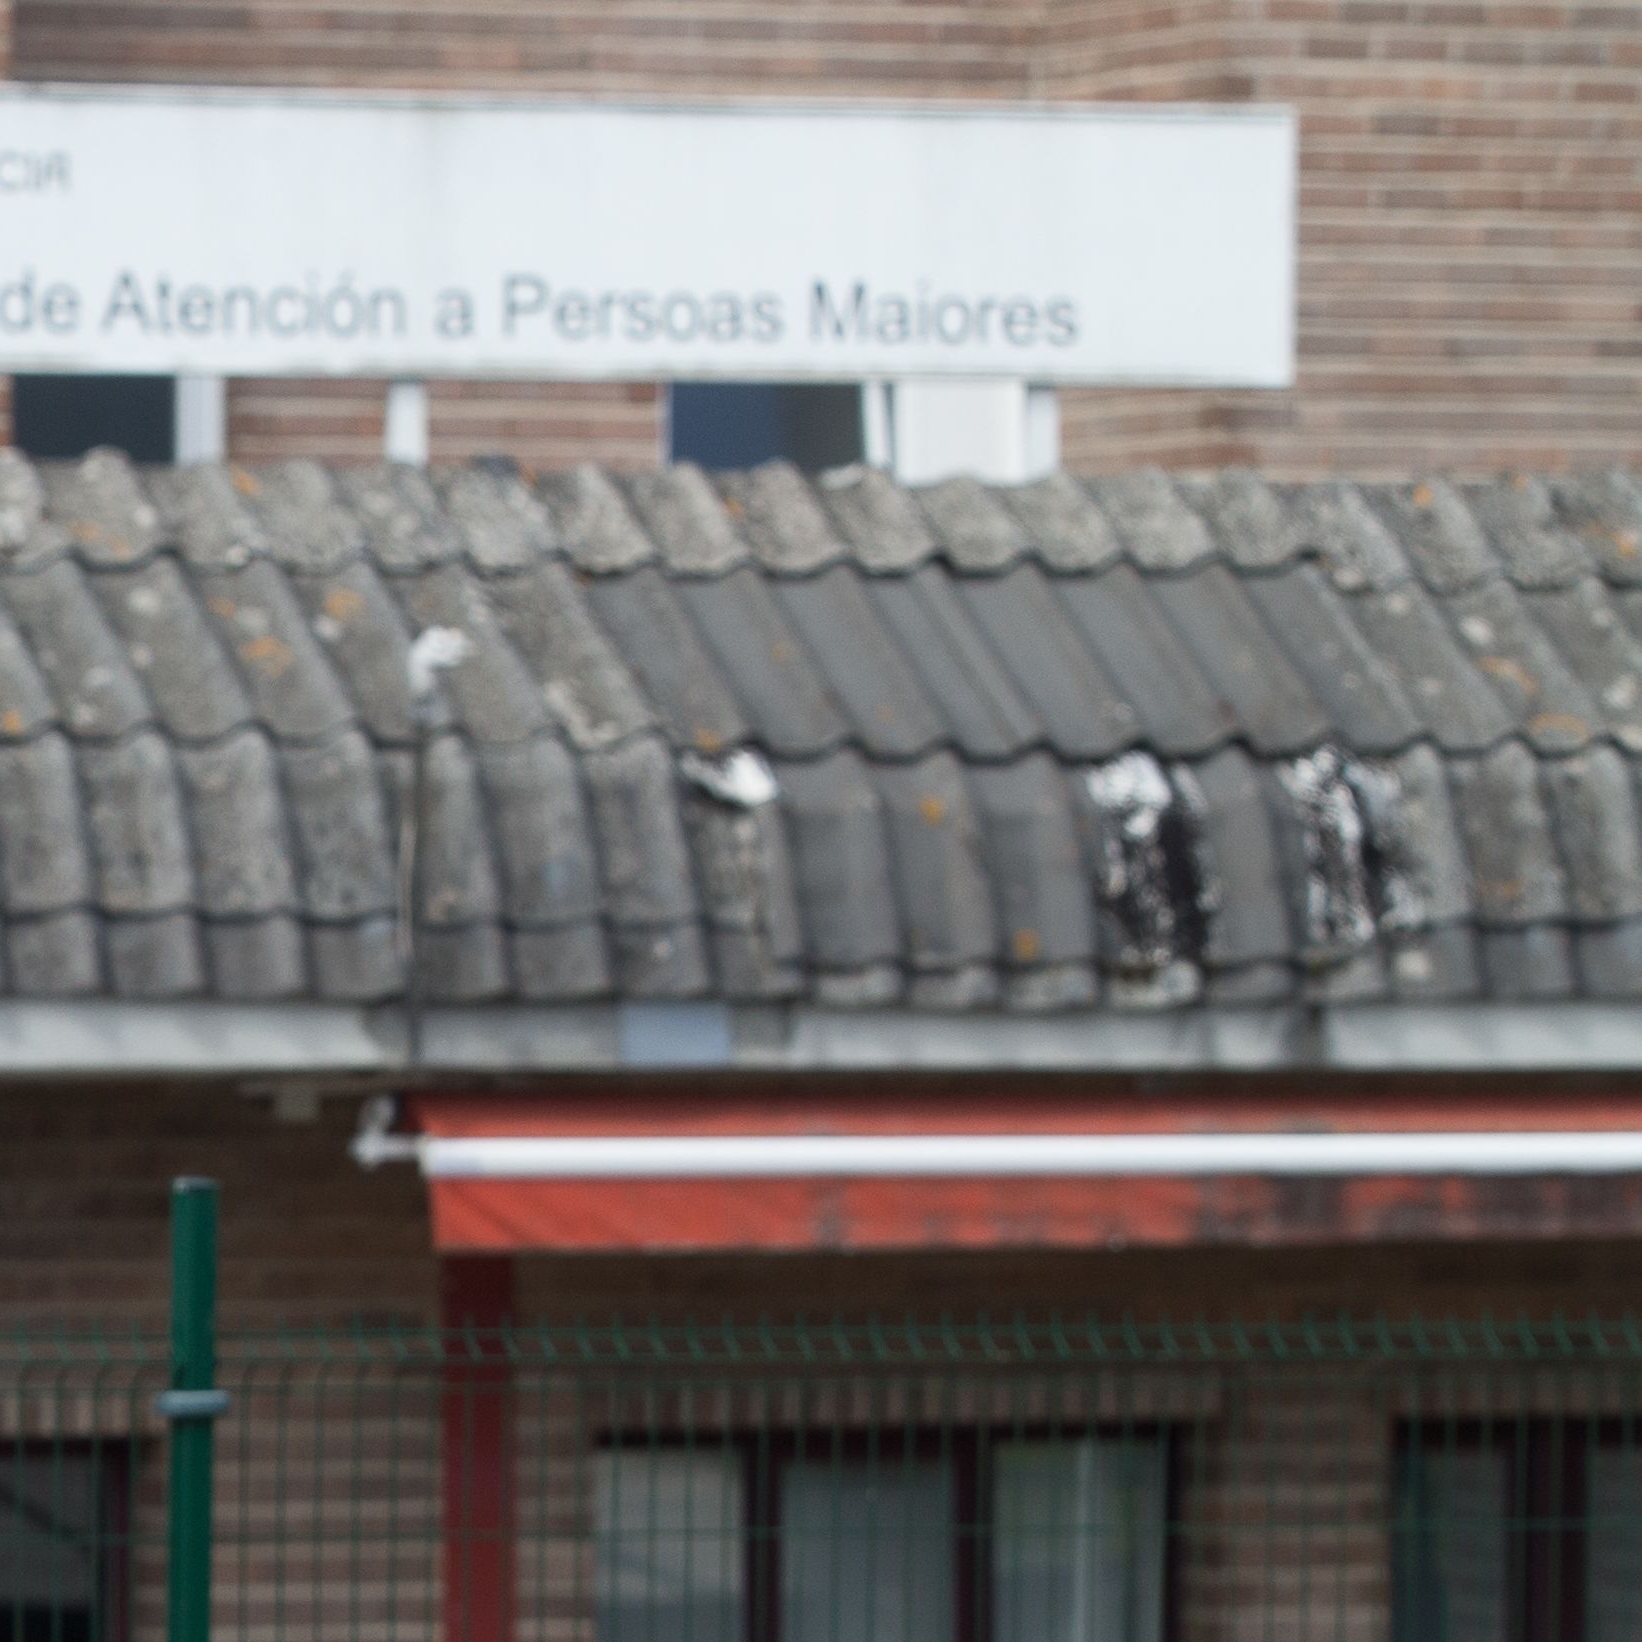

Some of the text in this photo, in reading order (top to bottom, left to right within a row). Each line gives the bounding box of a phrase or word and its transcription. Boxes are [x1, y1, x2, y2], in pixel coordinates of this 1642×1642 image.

[101, 271, 407, 340] Atención
[435, 288, 475, 342] a
[501, 274, 784, 344] Persoas
[810, 280, 1079, 347] Maiores
